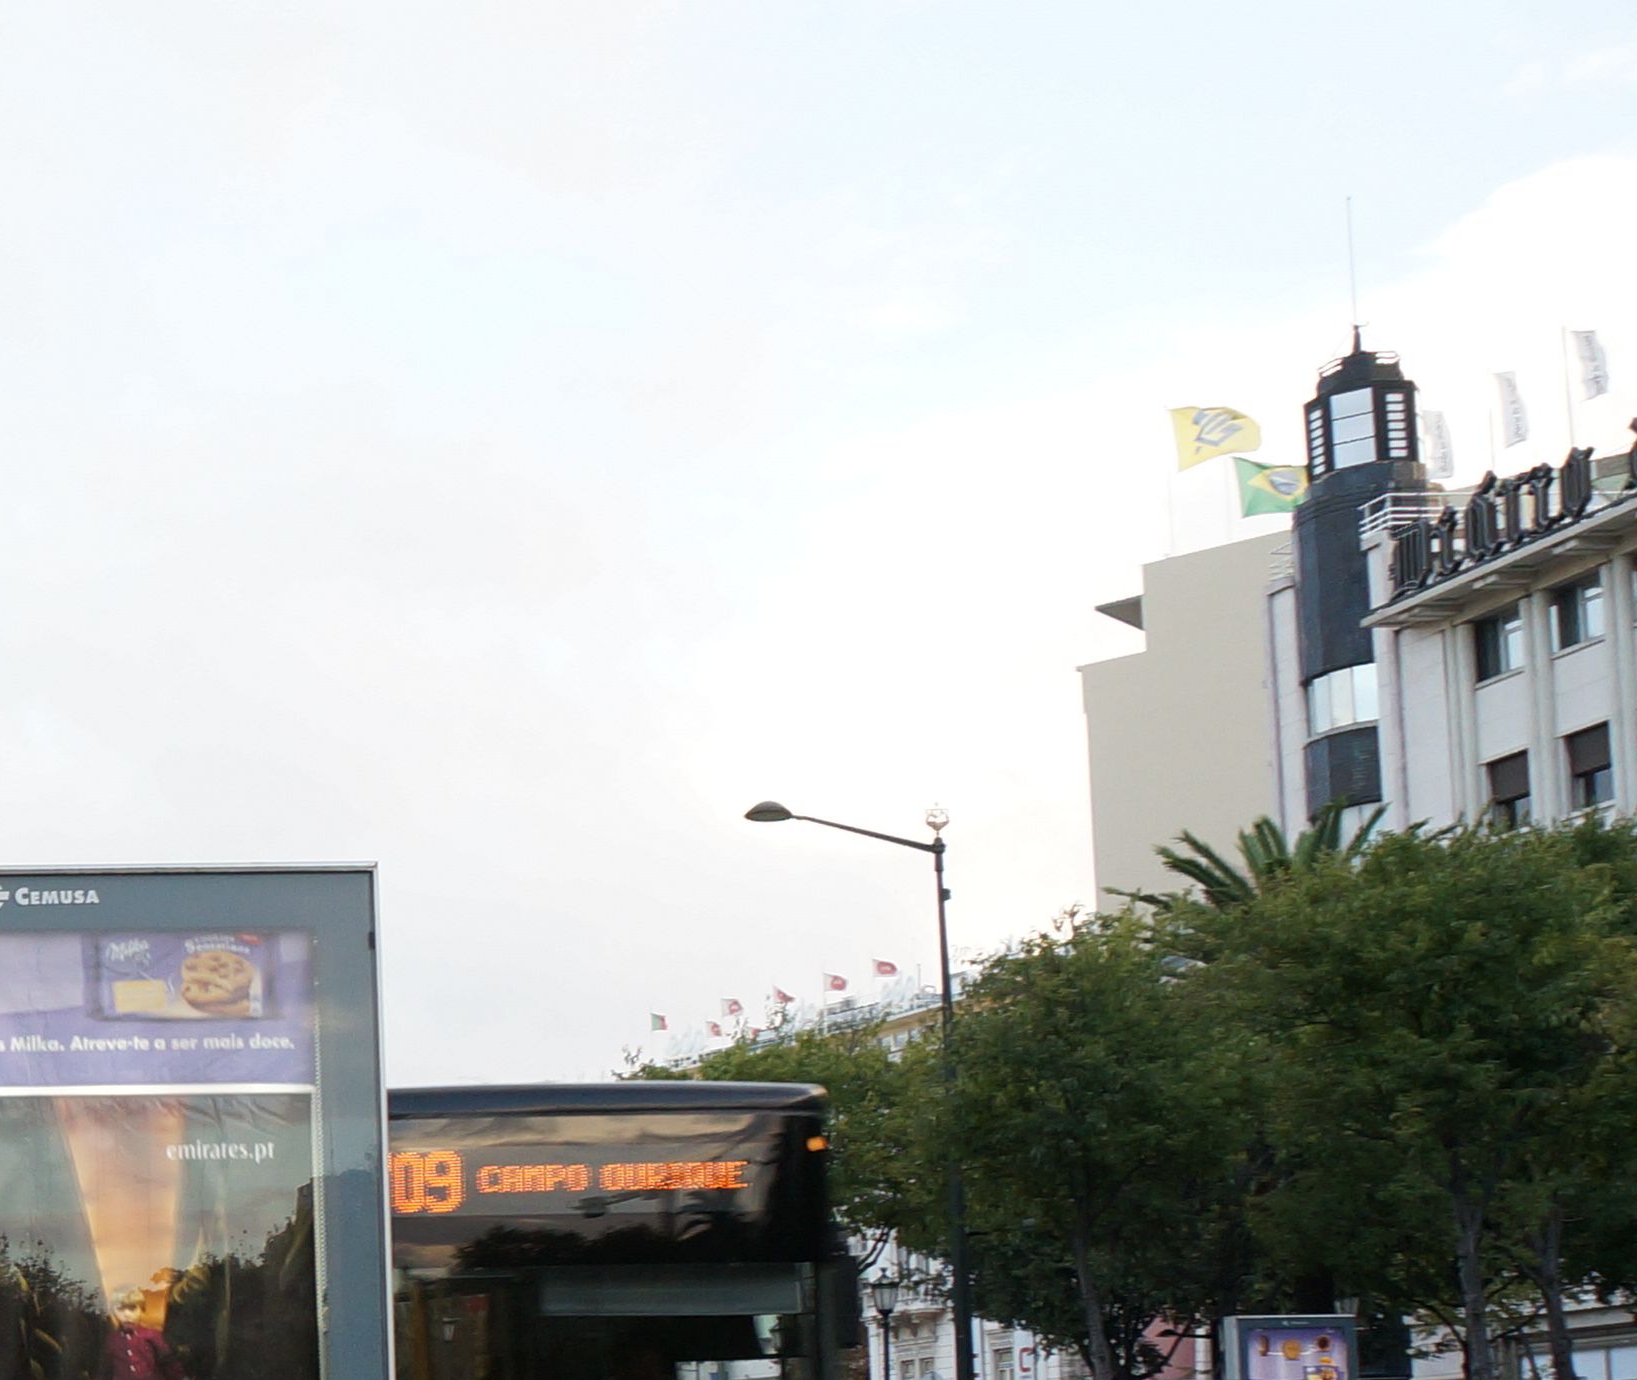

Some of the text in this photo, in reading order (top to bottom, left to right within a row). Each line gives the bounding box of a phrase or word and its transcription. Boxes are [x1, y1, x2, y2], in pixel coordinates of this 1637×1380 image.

[10, 1036, 66, 1052] Milka.
[70, 1034, 150, 1052] Atreve-te
[154, 1037, 166, 1050] a
[171, 1037, 199, 1050] ser
[203, 1033, 244, 1050] mais
[248, 1032, 296, 1050] doce.
[166, 1142, 276, 1164] emirates.pt
[387, 1150, 465, 1213] 09
[476, 1164, 590, 1192] CAMPO
